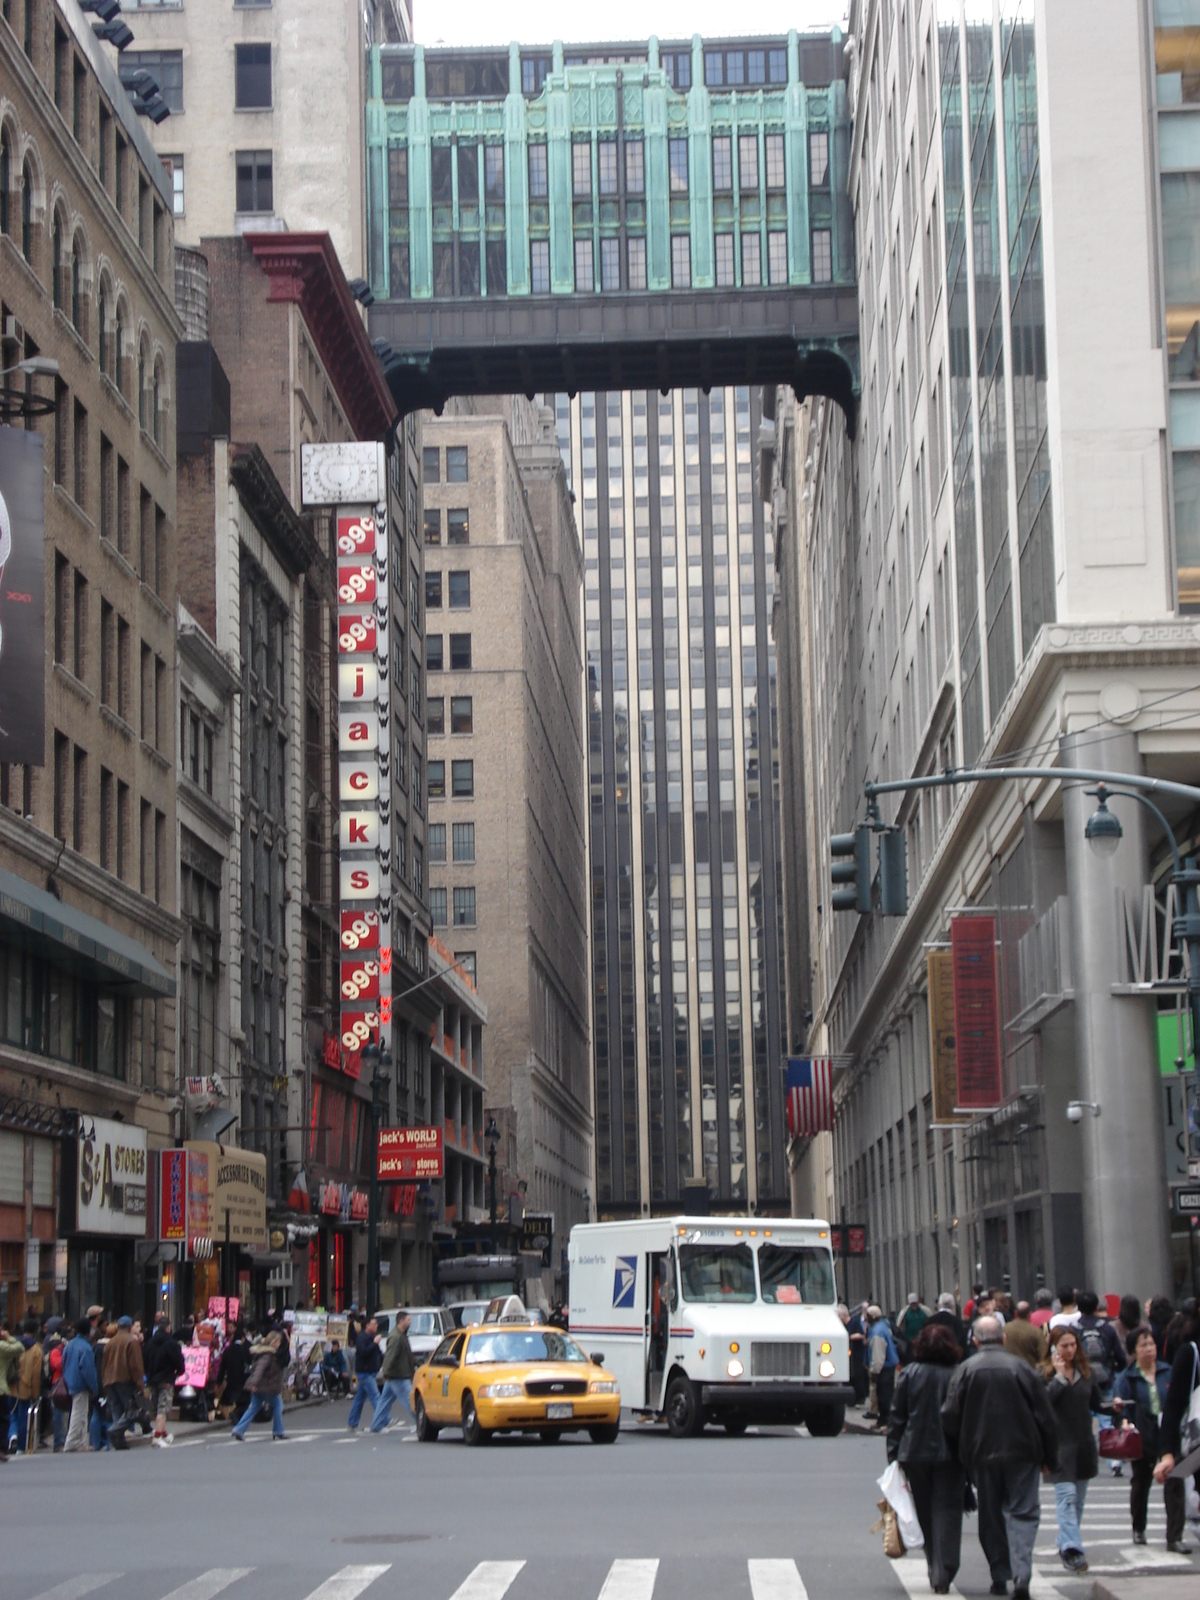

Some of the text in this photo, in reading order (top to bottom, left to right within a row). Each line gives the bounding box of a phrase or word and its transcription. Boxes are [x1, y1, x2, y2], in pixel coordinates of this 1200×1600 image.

[338, 516, 375, 555] 99¢
[338, 565, 375, 604] 99¢
[339, 613, 376, 652] 99¢
[341, 910, 379, 950] 99¢
[341, 960, 379, 1000] 99¢
[342, 1011, 379, 1052] 99¢
[379, 1129, 437, 1147] jack's WORLD
[99, 1142, 113, 1209] A
[114, 1144, 145, 1176] STORES
[379, 1157, 402, 1174] jack's
[416, 1157, 439, 1170] stores
[170, 1152, 182, 1224] JEWELRY
[524, 1221, 548, 1234] DELI
